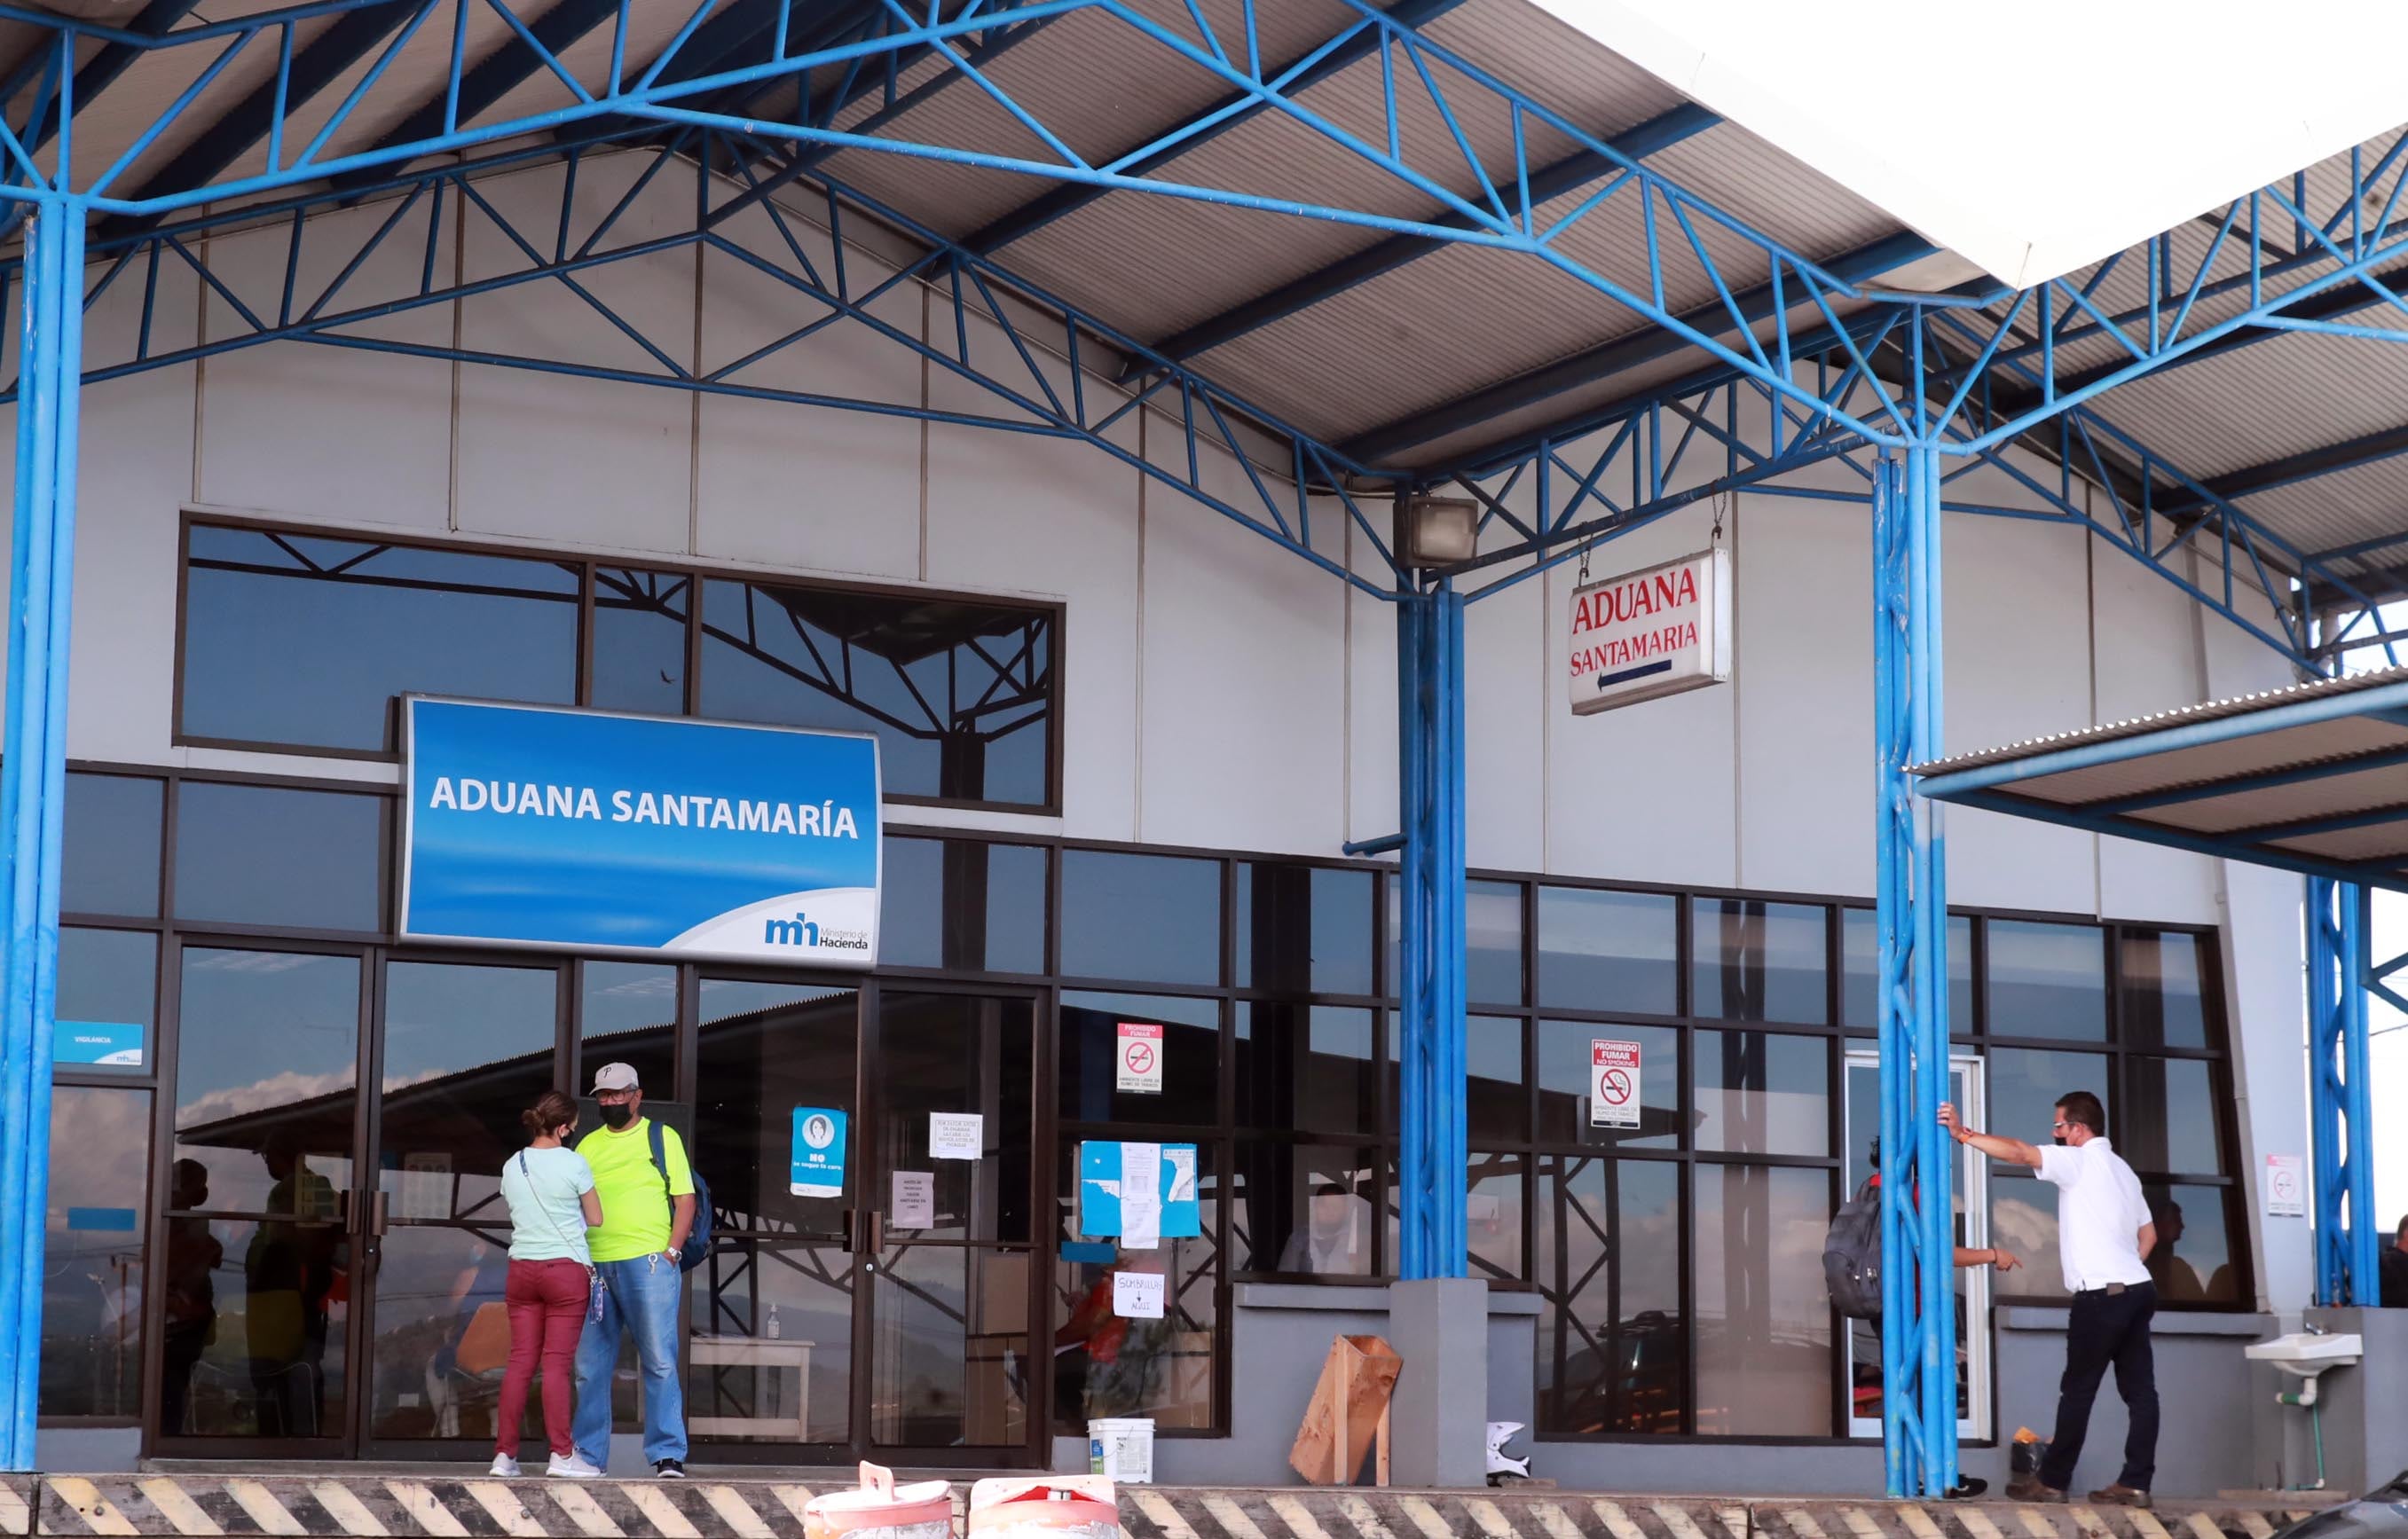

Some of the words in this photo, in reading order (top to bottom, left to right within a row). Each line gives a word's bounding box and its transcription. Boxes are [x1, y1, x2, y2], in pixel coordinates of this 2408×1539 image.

[1572, 567, 1697, 635] ADUANA
[1570, 622, 1698, 677] SANTAMARIA
[429, 777, 602, 821] ADUANA
[611, 789, 859, 839] SANTAMARÍA
[821, 928, 856, 938] Ministerio
[857, 930, 868, 938] de
[820, 937, 869, 949] Hacienda
[1594, 1042, 1638, 1053] PROHIBIDO
[1601, 1051, 1630, 1060] FUMAR
